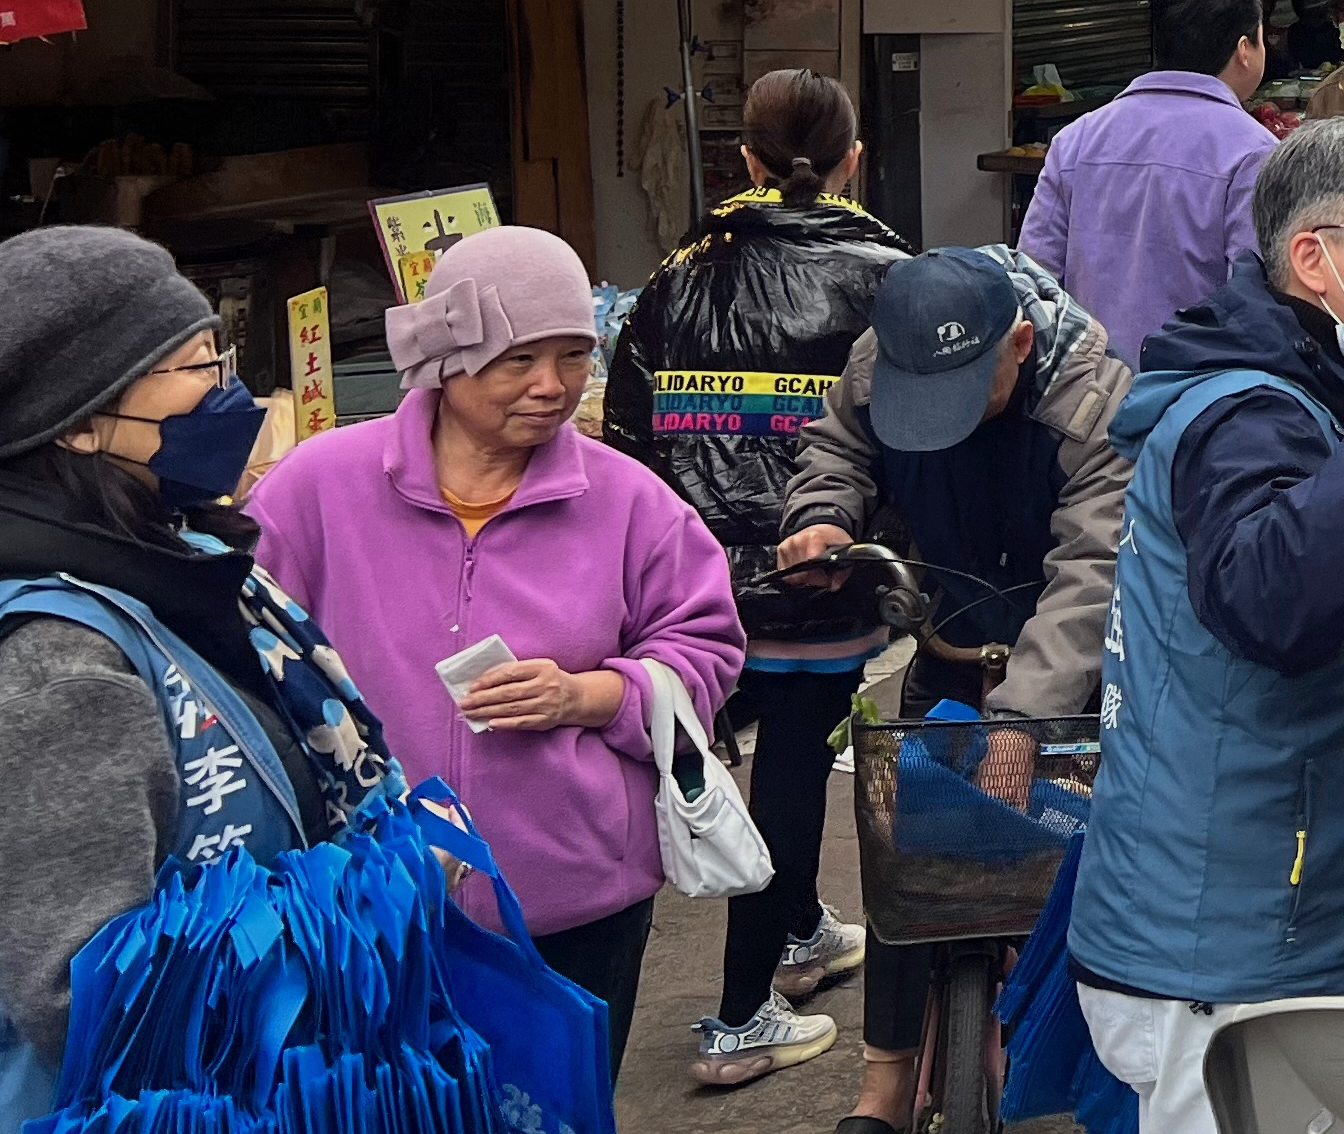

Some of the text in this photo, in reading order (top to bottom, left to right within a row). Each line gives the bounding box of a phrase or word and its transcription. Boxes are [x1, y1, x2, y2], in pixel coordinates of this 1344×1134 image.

[299, 324, 327, 433] 紅土鹹蛋
[654, 374, 744, 392] LIDARYO
